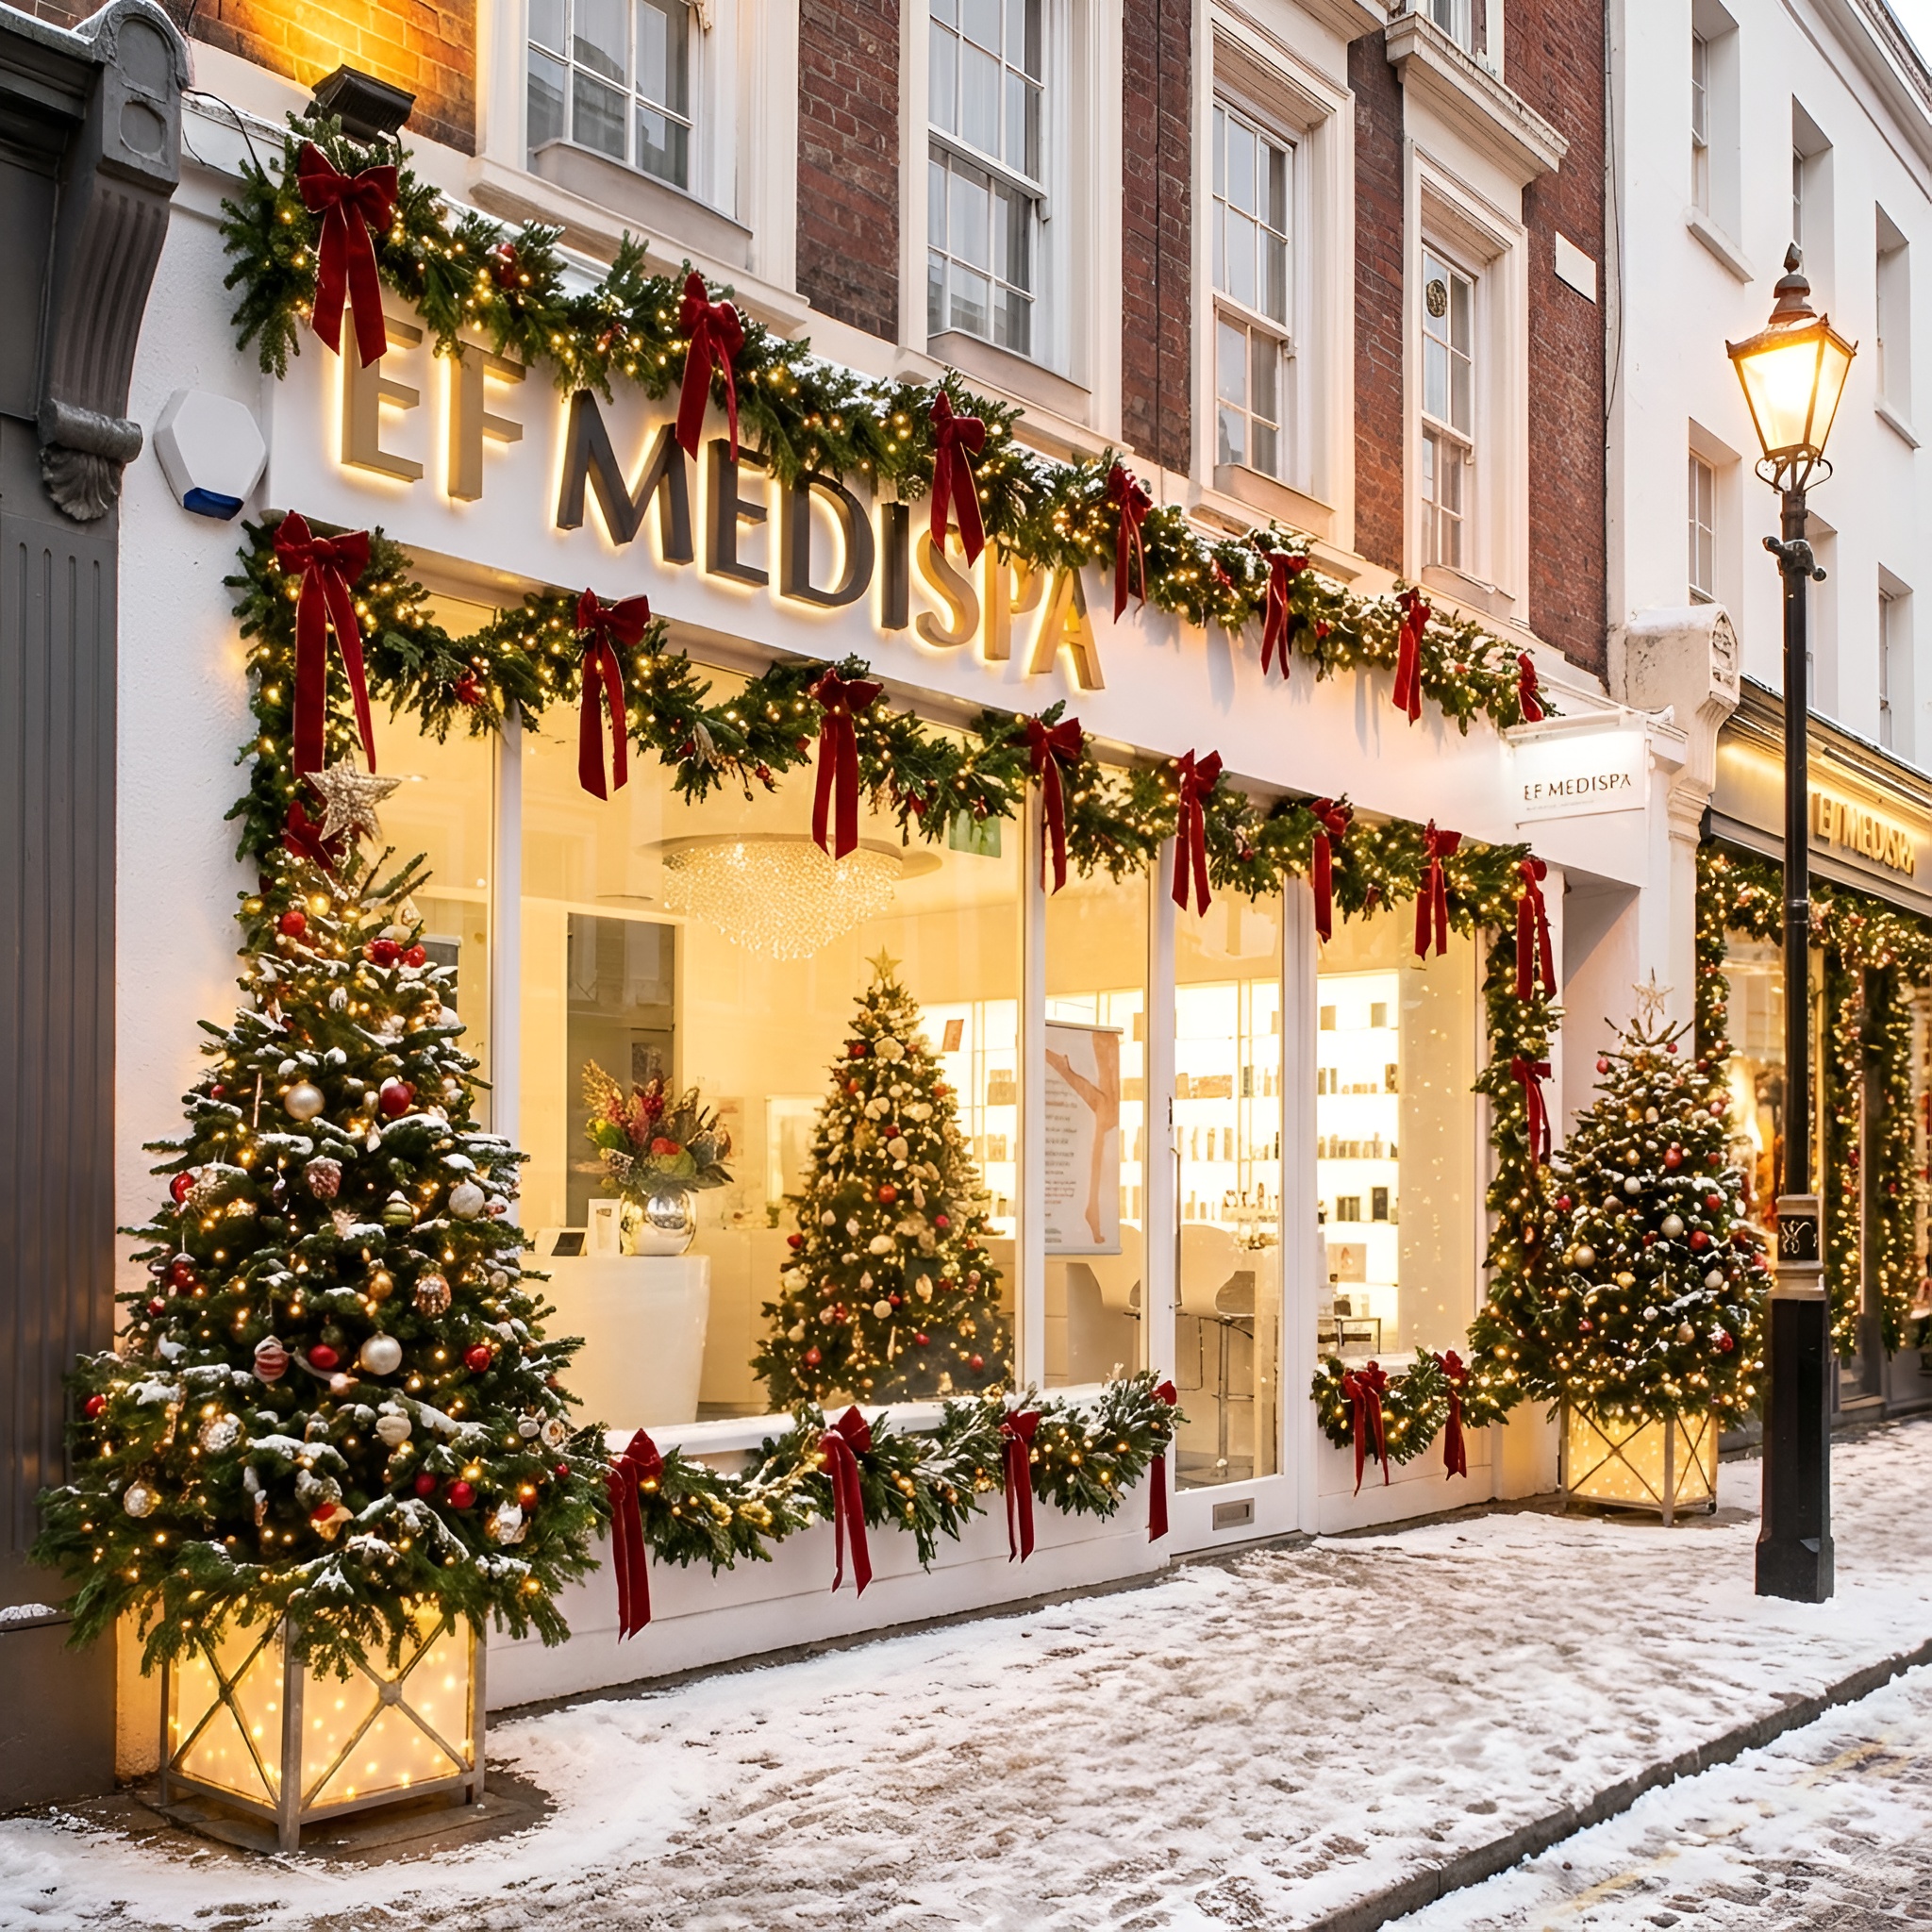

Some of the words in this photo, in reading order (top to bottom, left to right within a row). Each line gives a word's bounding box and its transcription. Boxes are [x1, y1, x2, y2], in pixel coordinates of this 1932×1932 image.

[341, 308, 526, 502] EF
[557, 388, 1106, 691] MEDISPA
[1524, 784, 1542, 801] EF
[1548, 774, 1632, 797] MEDISPA
